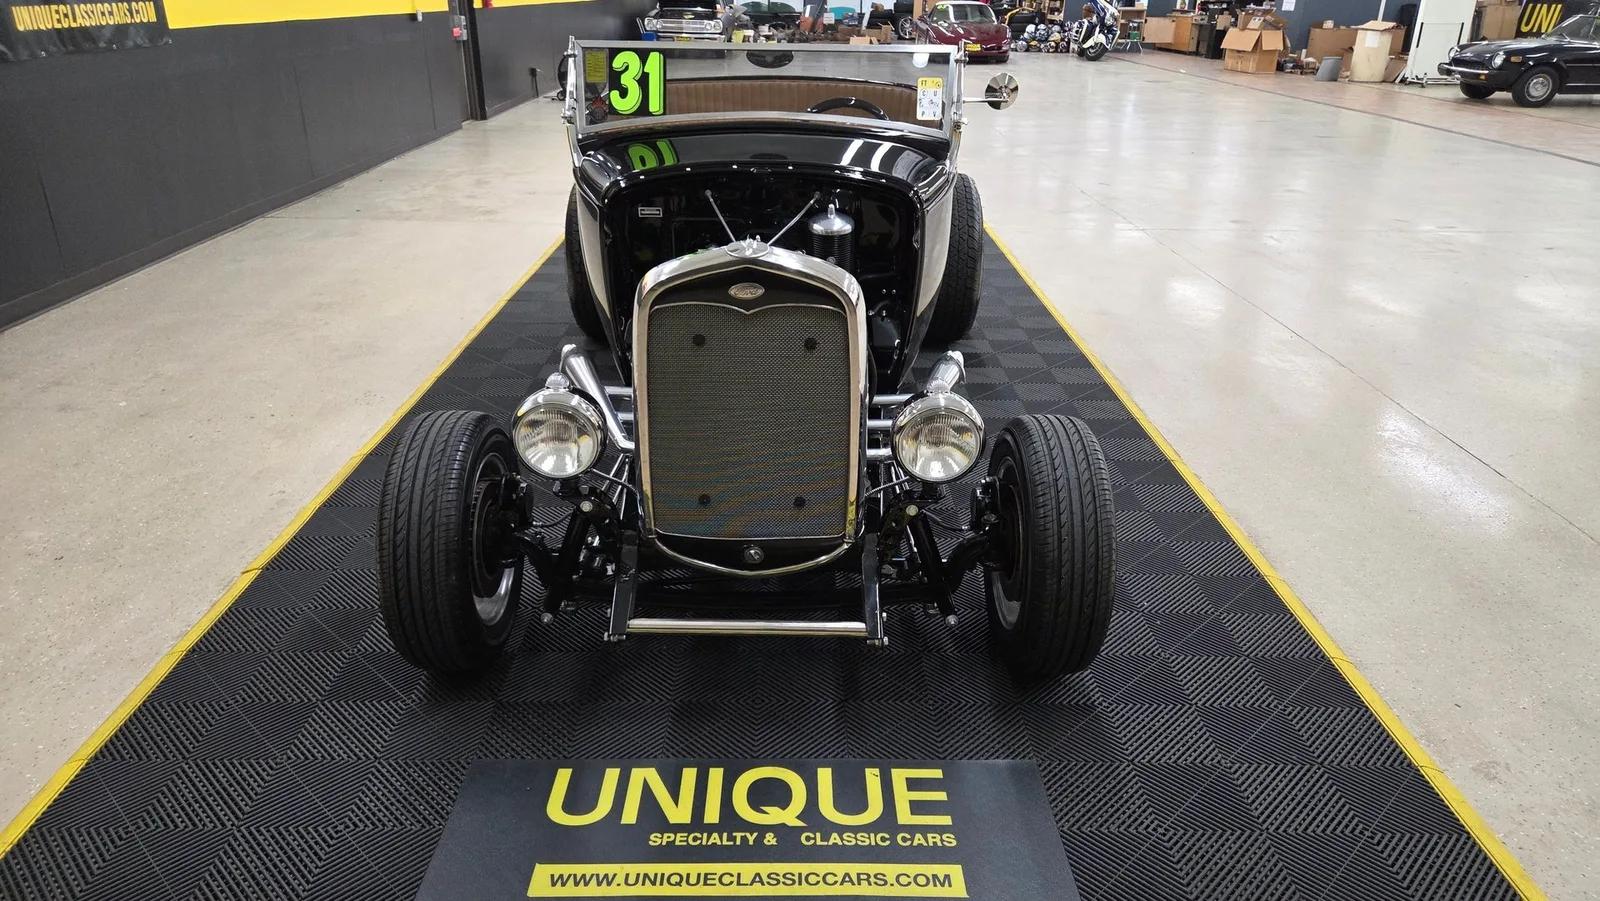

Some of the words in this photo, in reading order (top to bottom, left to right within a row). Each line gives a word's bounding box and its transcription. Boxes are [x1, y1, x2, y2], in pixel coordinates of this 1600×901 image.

[11, 1, 157, 31] UNIQUECLASSICCARS.COM
[610, 50, 664, 115] 31
[546, 766, 953, 827] UNIQUE
[648, 831, 757, 847] SPECIALTY
[763, 831, 778, 846] &
[800, 831, 891, 847] CLASSIC
[896, 832, 958, 847] CARS
[549, 869, 953, 889] WWW.UNIQUECLASSICCARS.COM
